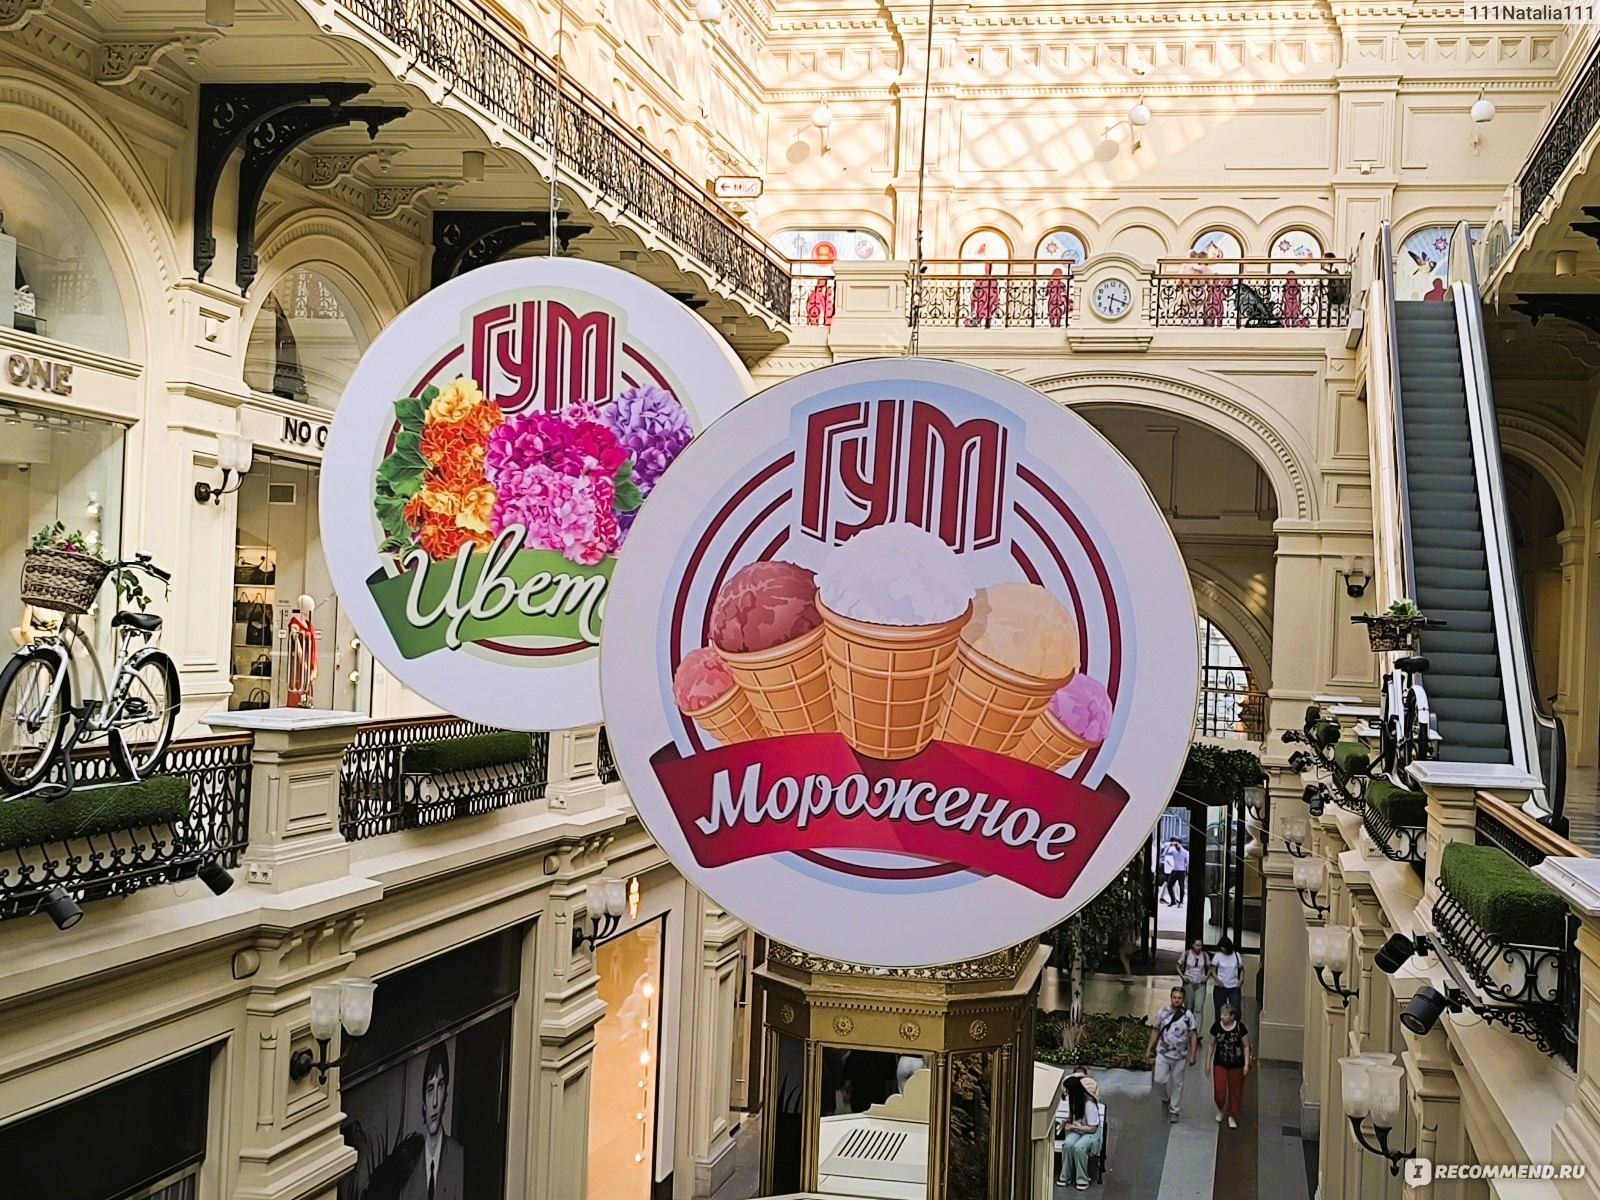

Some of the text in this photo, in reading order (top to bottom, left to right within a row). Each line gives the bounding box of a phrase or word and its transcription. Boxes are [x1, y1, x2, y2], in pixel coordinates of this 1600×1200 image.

[9, 354, 73, 396] ONE
[284, 416, 312, 443] NO
[403, 523, 609, 651] Цвет
[695, 762, 1077, 862] Мороженое
